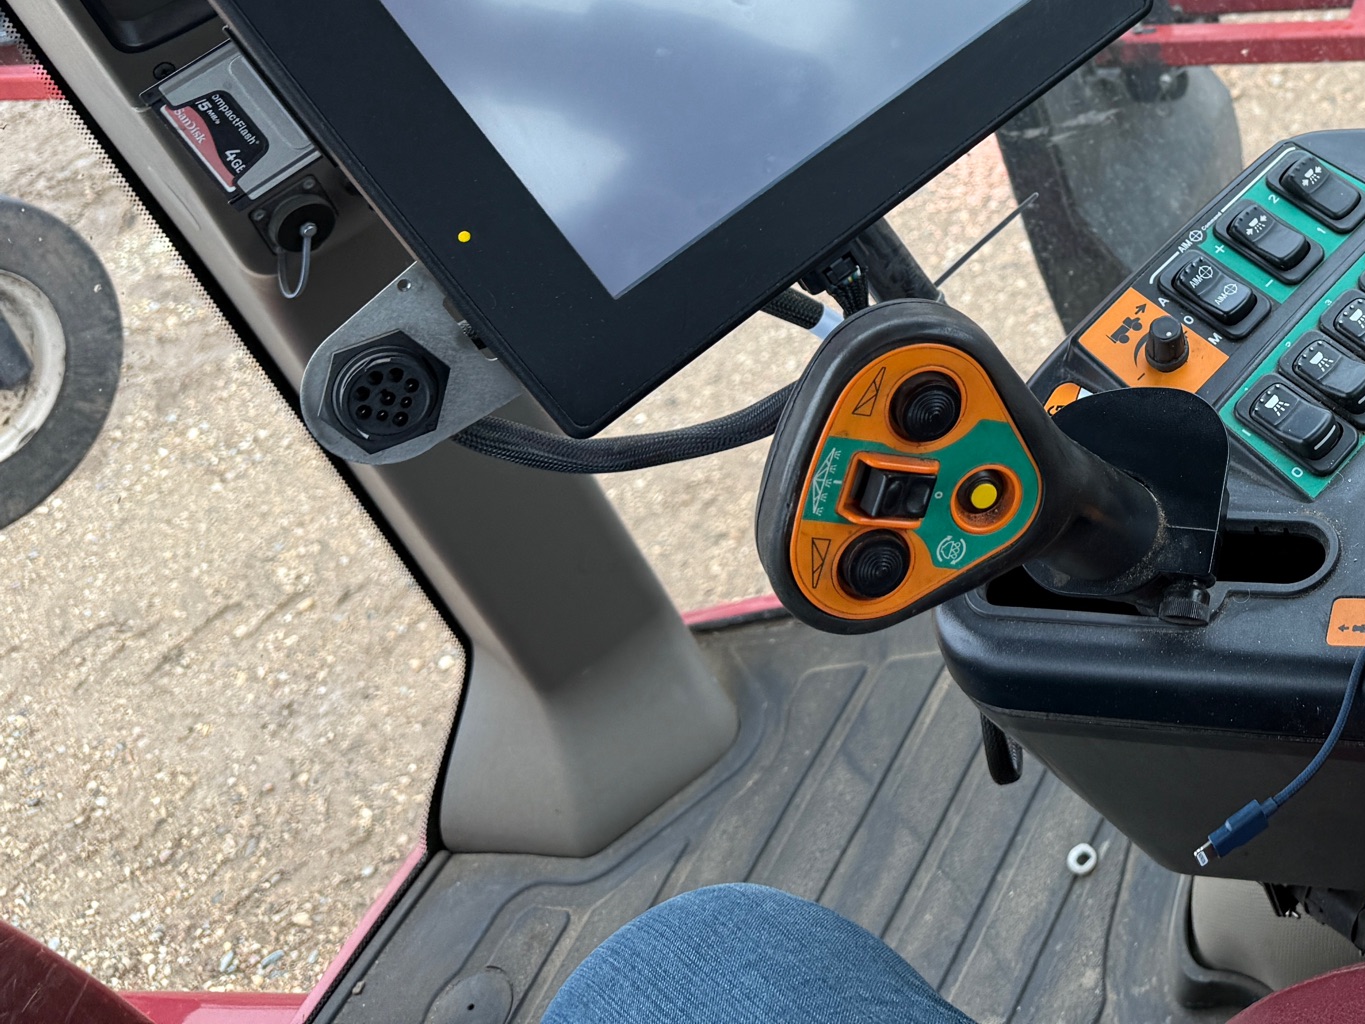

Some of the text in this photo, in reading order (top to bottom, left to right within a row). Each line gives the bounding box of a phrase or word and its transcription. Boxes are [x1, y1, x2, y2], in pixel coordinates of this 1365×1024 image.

[173, 107, 206, 145] SanDisk
[211, 94, 256, 145] ompactFlash
[1268, 194, 1281, 205] 2
[1177, 211, 1223, 254] AIM Command
[1188, 274, 1204, 289] AIM
[1157, 297, 1170, 308] A
[1214, 292, 1228, 306] AIM
[1207, 332, 1223, 346] M
